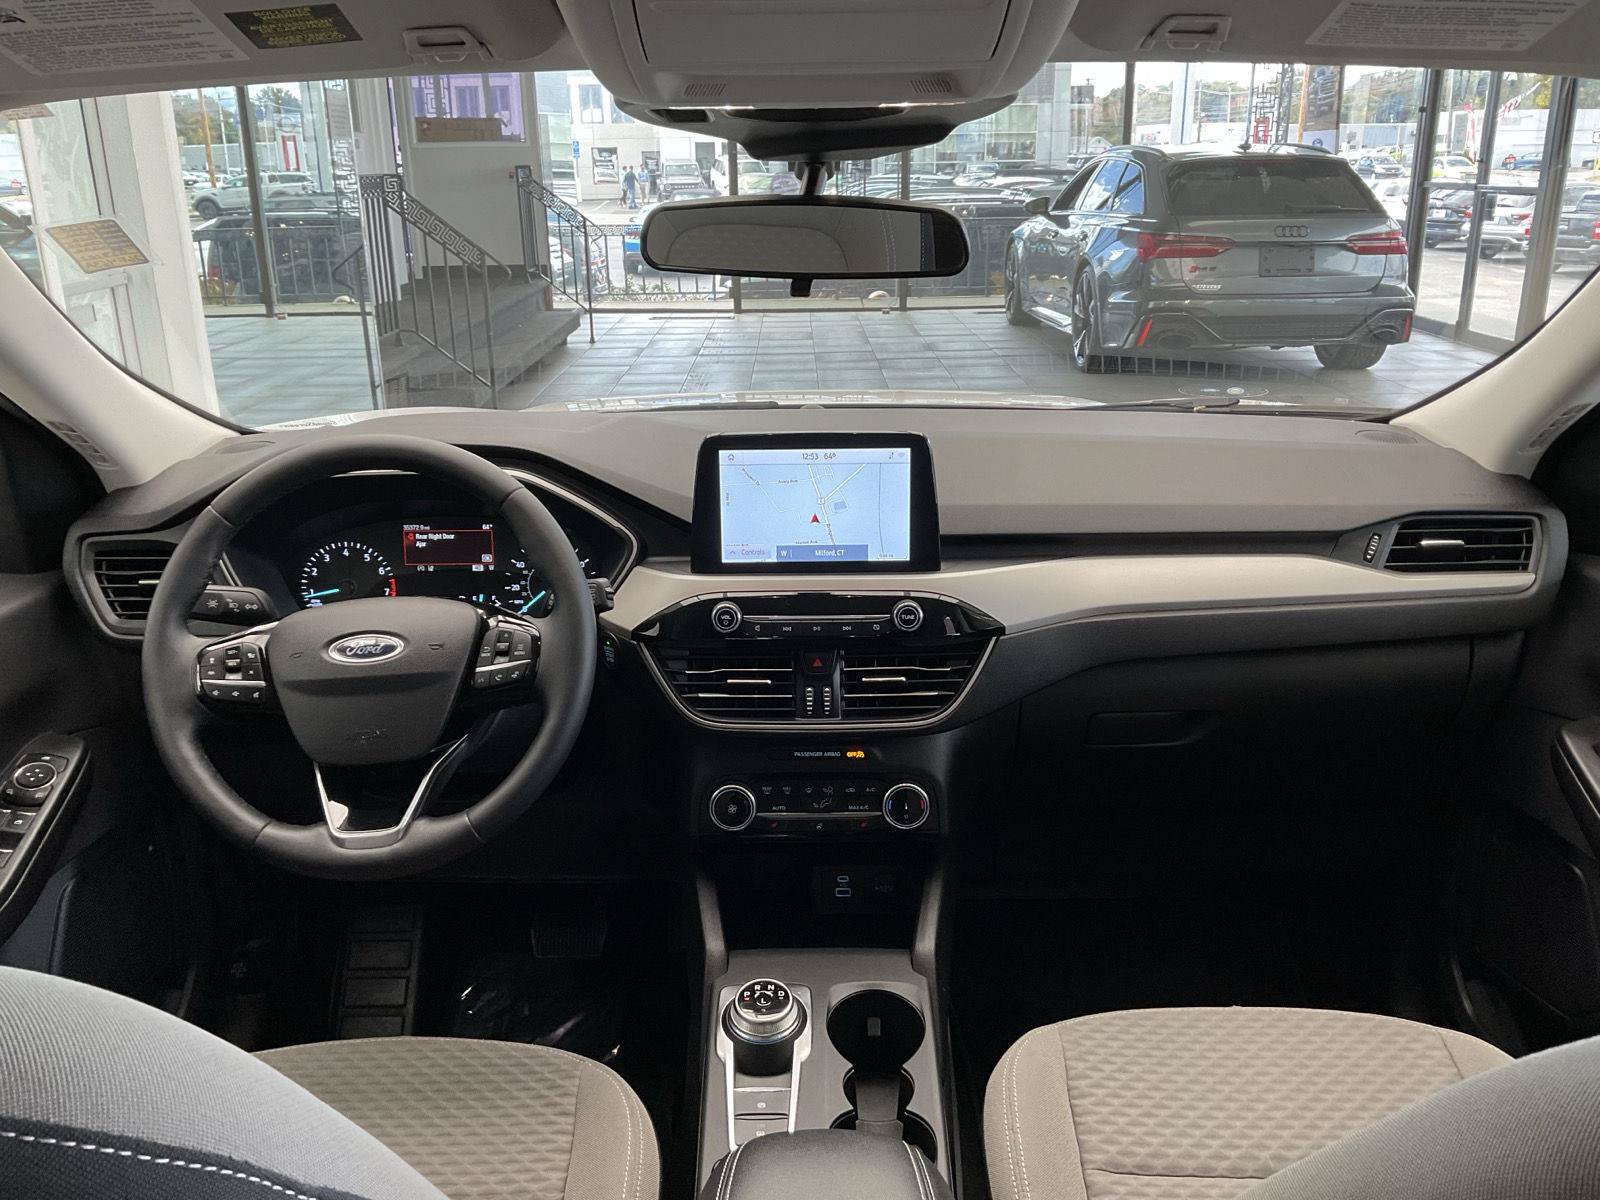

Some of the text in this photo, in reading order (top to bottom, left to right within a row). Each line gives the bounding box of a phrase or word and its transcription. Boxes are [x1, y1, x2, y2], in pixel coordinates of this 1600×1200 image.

[428, 533, 442, 541] Right
[741, 549, 766, 557] Controls
[780, 549, 788, 557] W
[311, 568, 318, 576] 2
[378, 567, 385, 575] 6
[384, 588, 390, 596] 7
[345, 641, 385, 656] Ford
